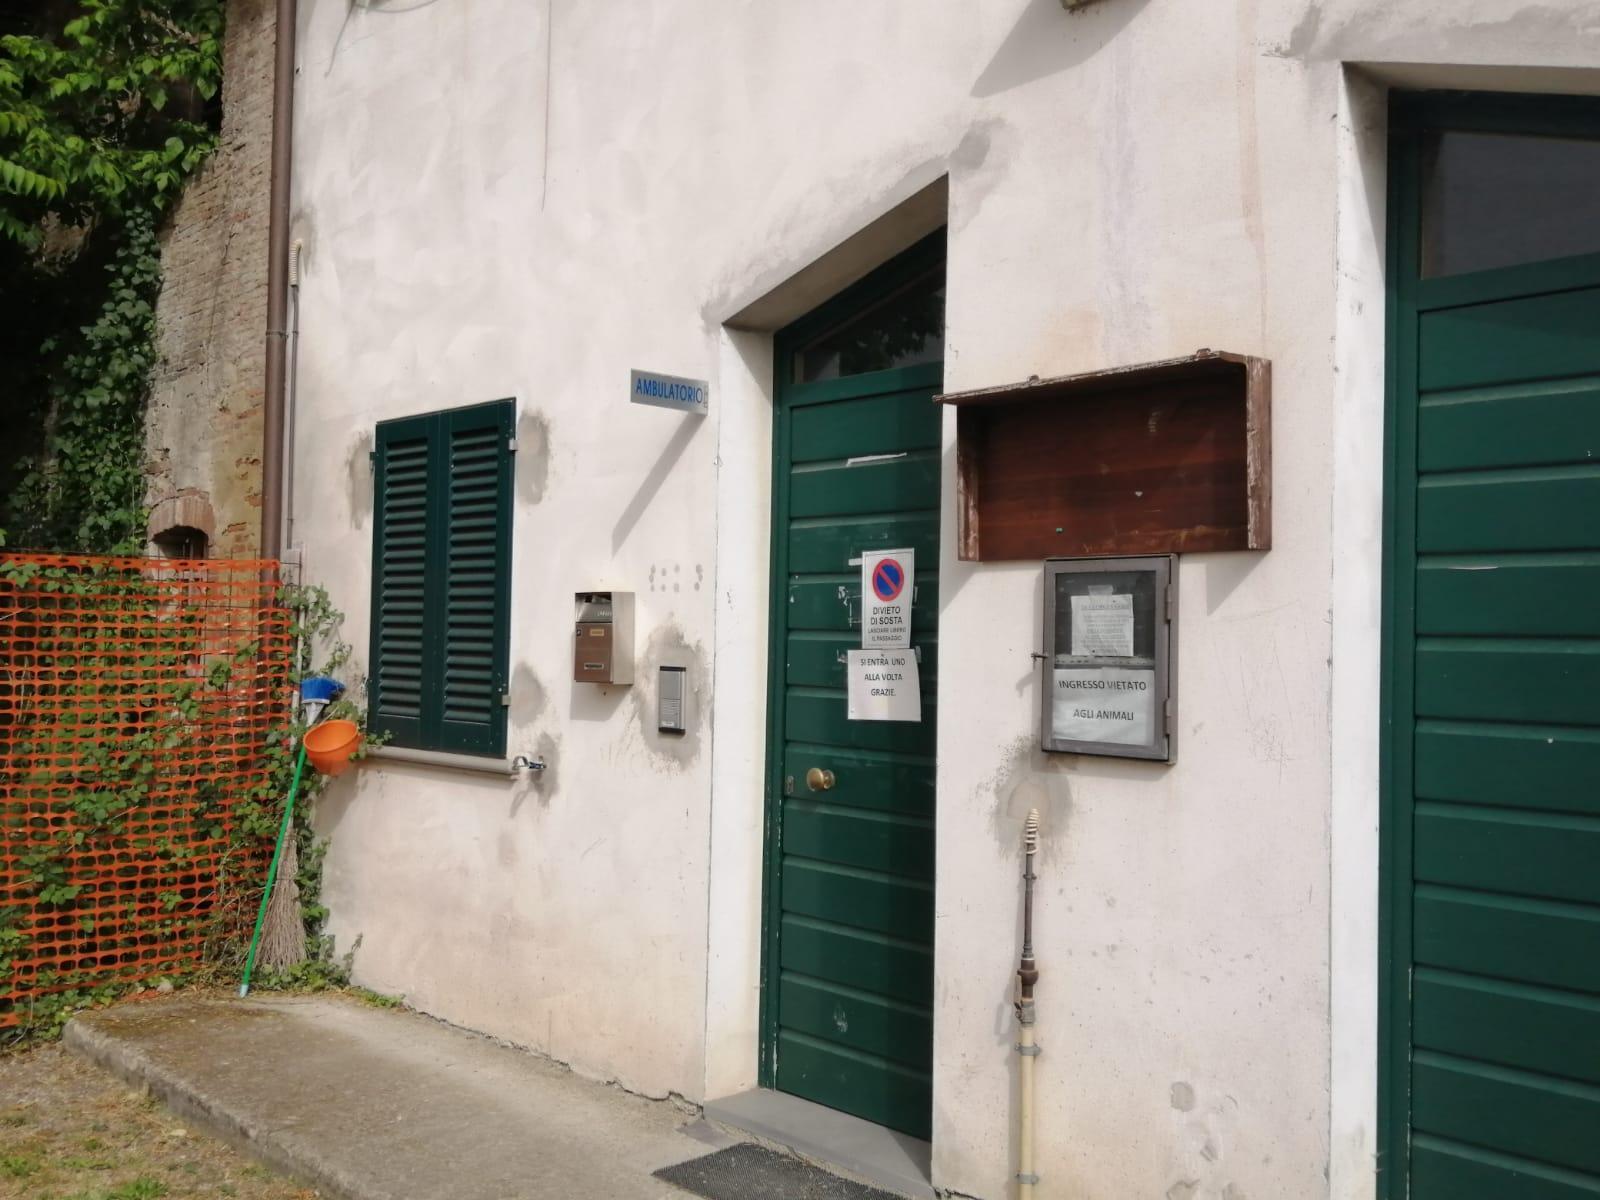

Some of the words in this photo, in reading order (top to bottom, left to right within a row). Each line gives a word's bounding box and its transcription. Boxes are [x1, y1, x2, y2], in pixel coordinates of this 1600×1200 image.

[636, 378, 703, 403] AMBULATORIO
[873, 606, 900, 614] DIVIETO
[871, 617, 877, 625] DI
[879, 617, 902, 625] SOSTA
[1058, 680, 1104, 689] INGRESSO
[1107, 681, 1146, 690] VIETATO
[1073, 709, 1094, 719] AGLI
[1096, 710, 1134, 720] ANIMALI
